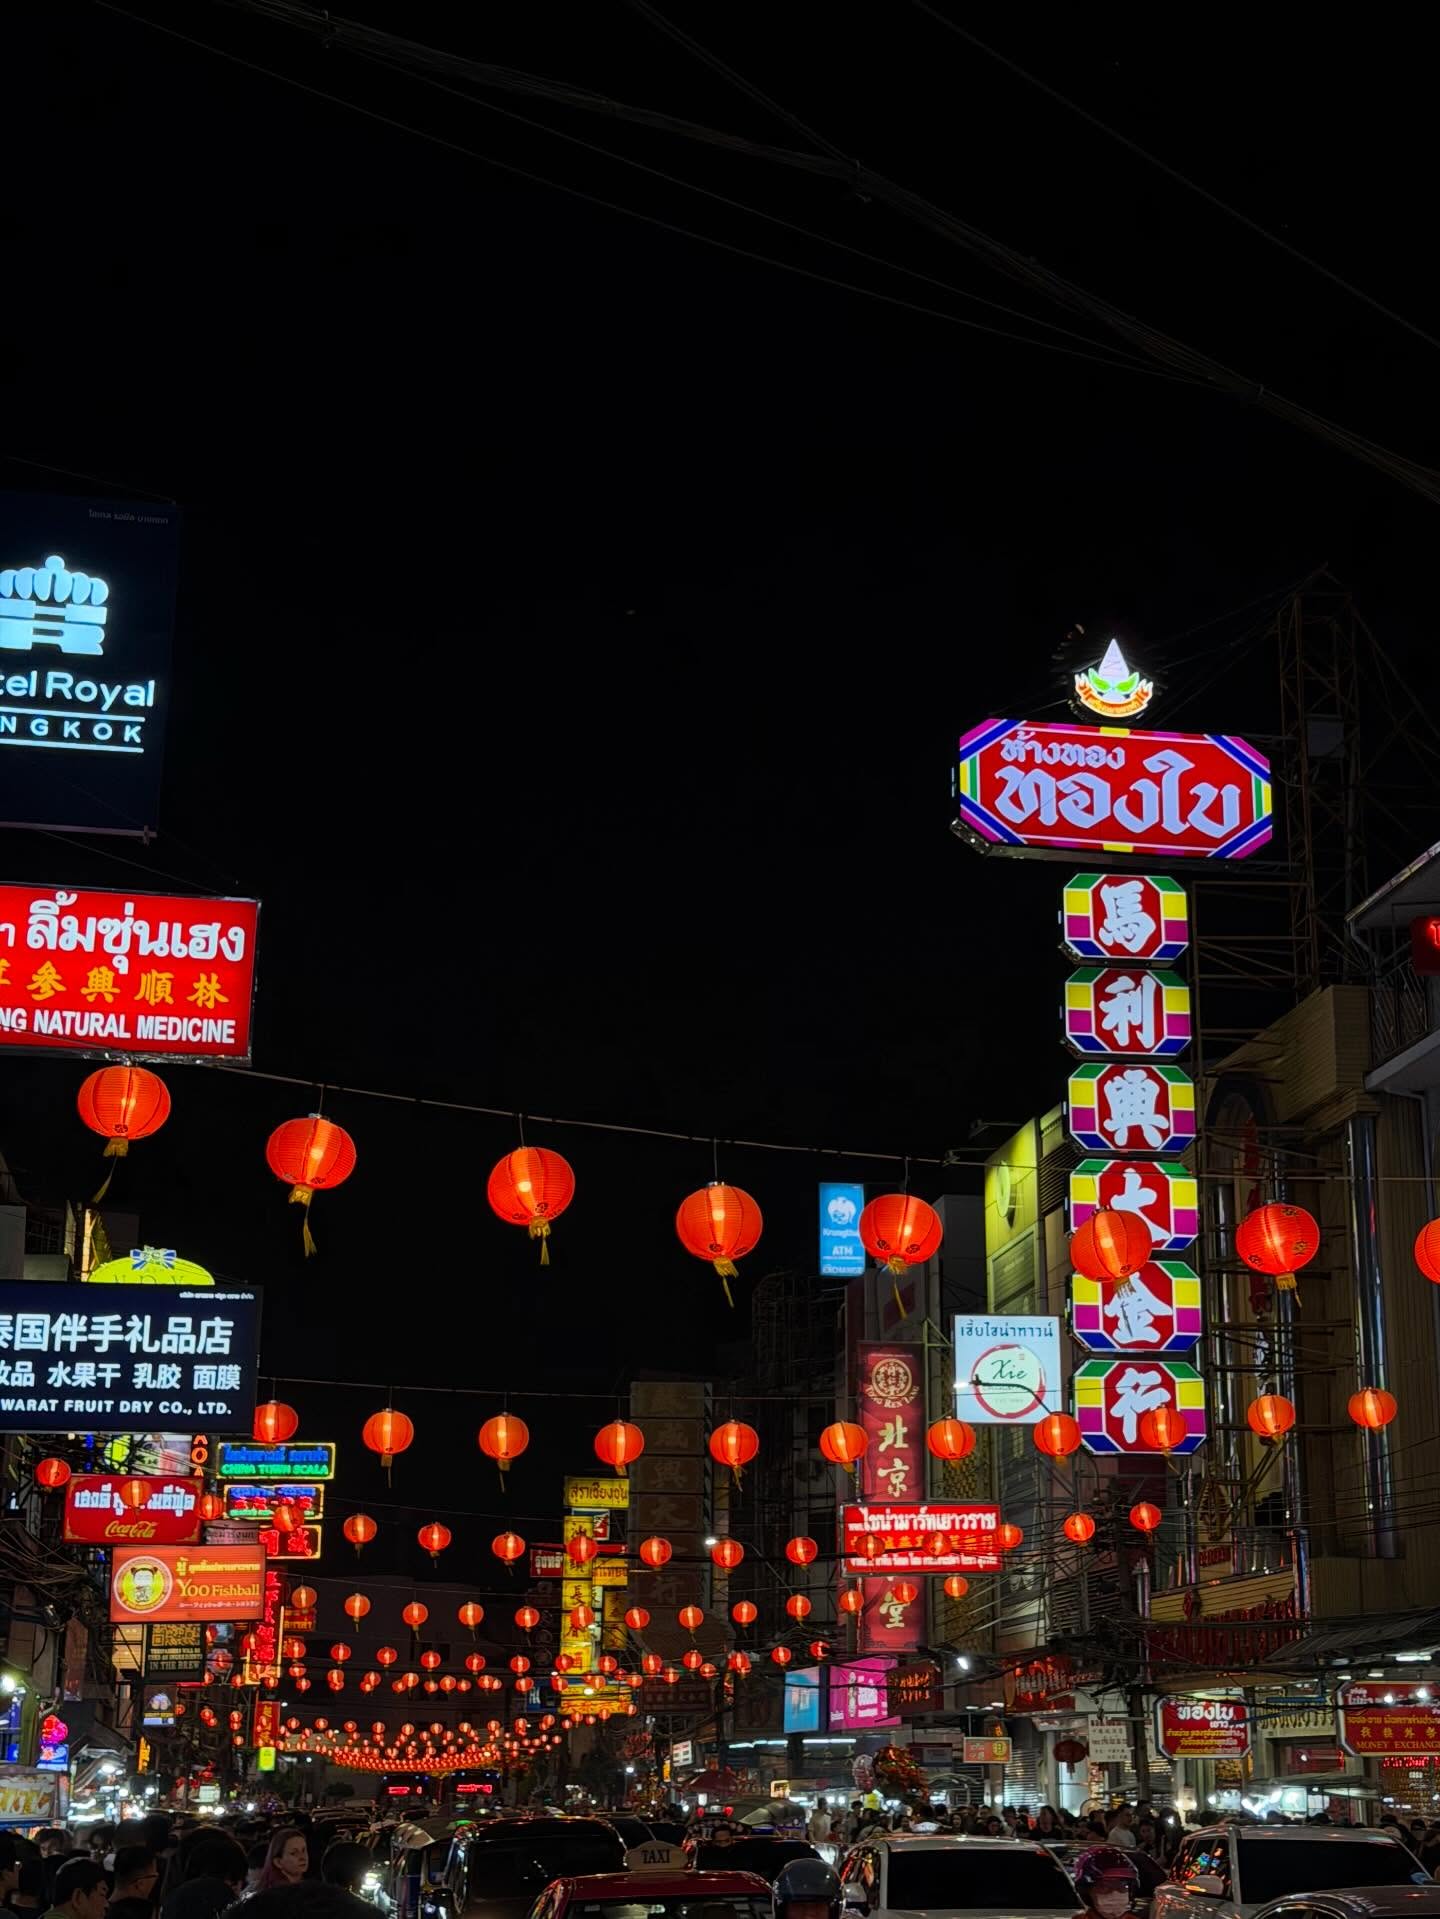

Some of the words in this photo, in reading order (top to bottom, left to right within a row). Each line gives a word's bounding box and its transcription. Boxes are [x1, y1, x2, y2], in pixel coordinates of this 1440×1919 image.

[45, 671, 155, 712] Royal
[994, 749, 1241, 839] ทองใบ
[0, 1007, 28, 1033] NG
[33, 1008, 132, 1039] NATURAL
[136, 1014, 236, 1044] MEDICINE
[46, 1360, 122, 1389] 水果干
[132, 1362, 182, 1390] 乳胶
[192, 1364, 242, 1391] 面膜
[990, 1359, 1028, 1380] Xie
[1, 1398, 60, 1412] WARAT
[63, 1399, 115, 1413] FRUIT
[119, 1400, 154, 1413] DRY
[158, 1400, 193, 1416] CO.,
[197, 1401, 232, 1415] LTD.
[292, 1463, 329, 1475] SCALA
[211, 1583, 260, 1597] Fishball
[1356, 1740, 1390, 1749] MONEY
[641, 1848, 670, 1864] TAXI
